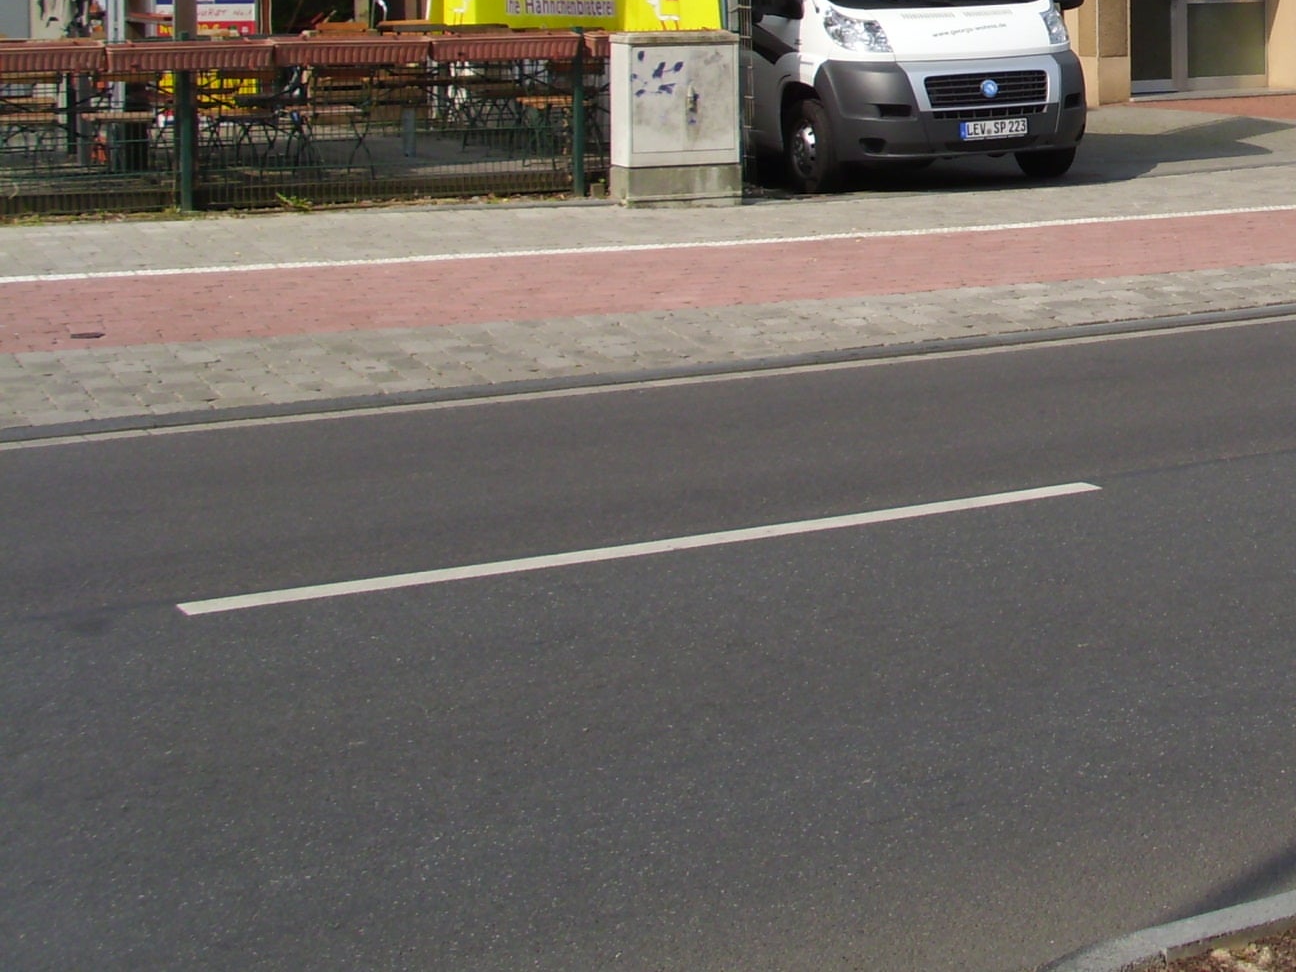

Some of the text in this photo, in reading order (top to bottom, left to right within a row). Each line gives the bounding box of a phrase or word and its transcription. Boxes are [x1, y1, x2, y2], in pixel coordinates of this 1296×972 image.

[967, 120, 1026, 135] LEV SP 223
